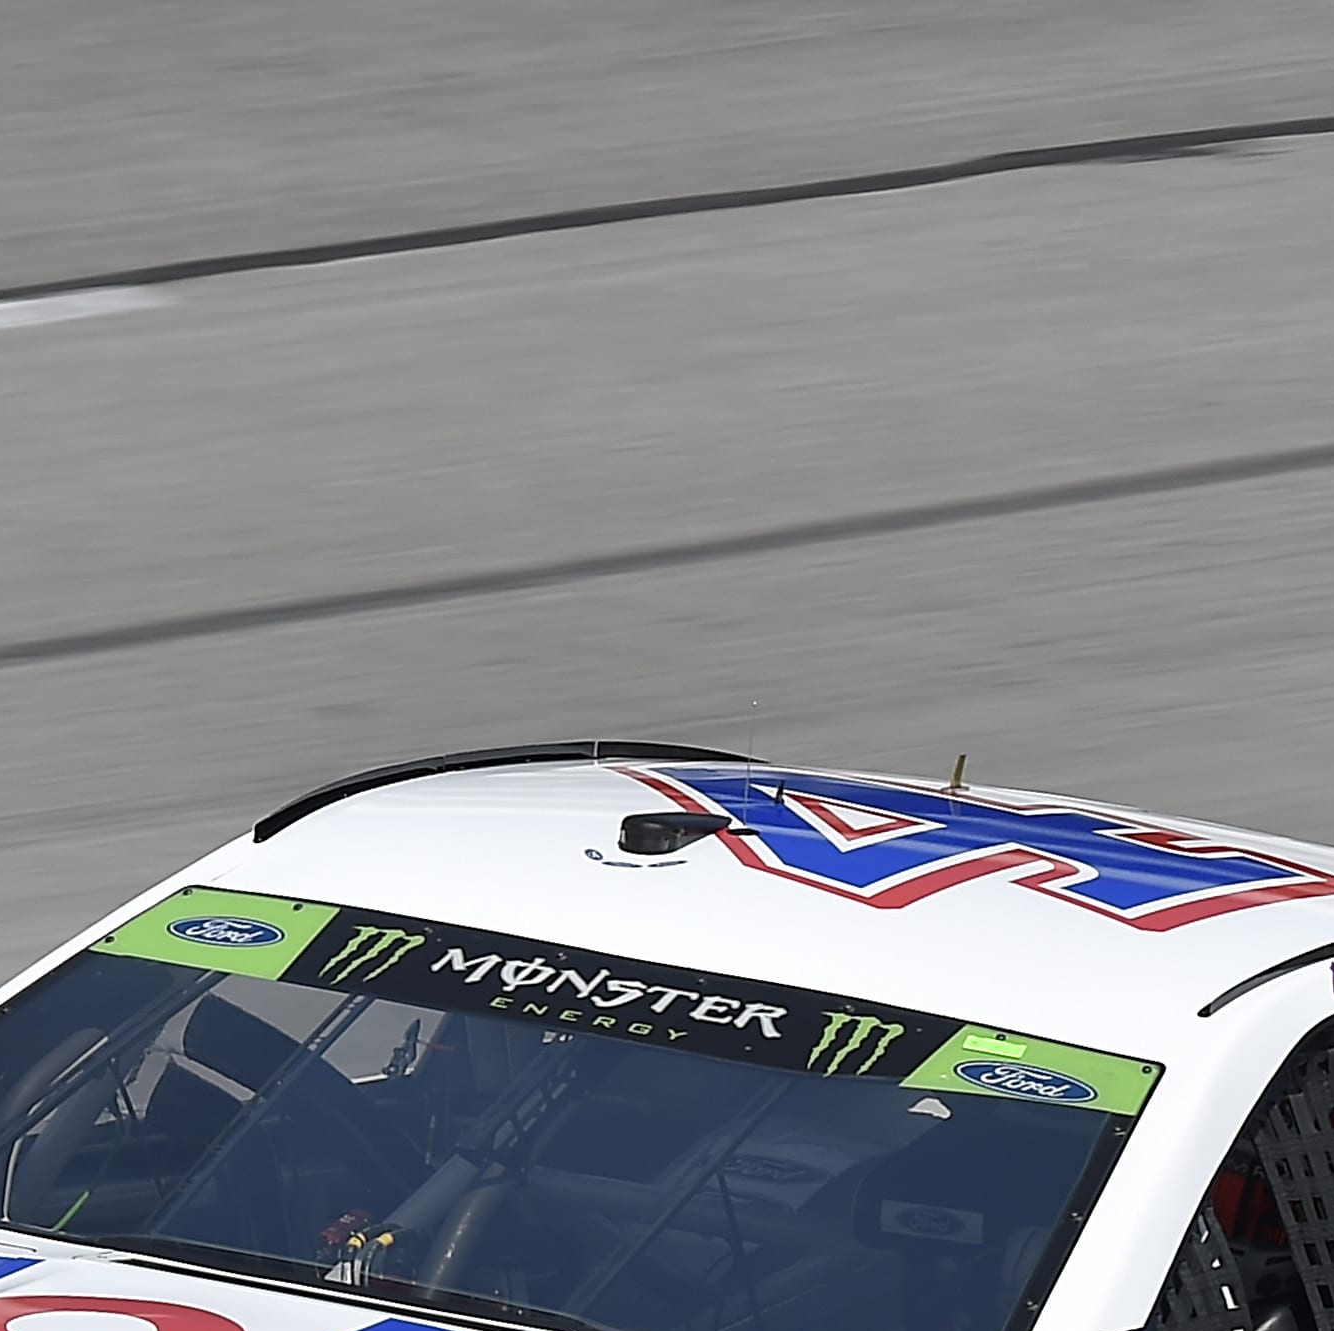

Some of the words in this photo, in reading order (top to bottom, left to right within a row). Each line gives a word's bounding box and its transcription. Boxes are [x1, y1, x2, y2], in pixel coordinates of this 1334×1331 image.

[184, 917, 265, 946] Ford
[488, 995, 688, 1042] ENERGY
[979, 1064, 1070, 1100] Ford
